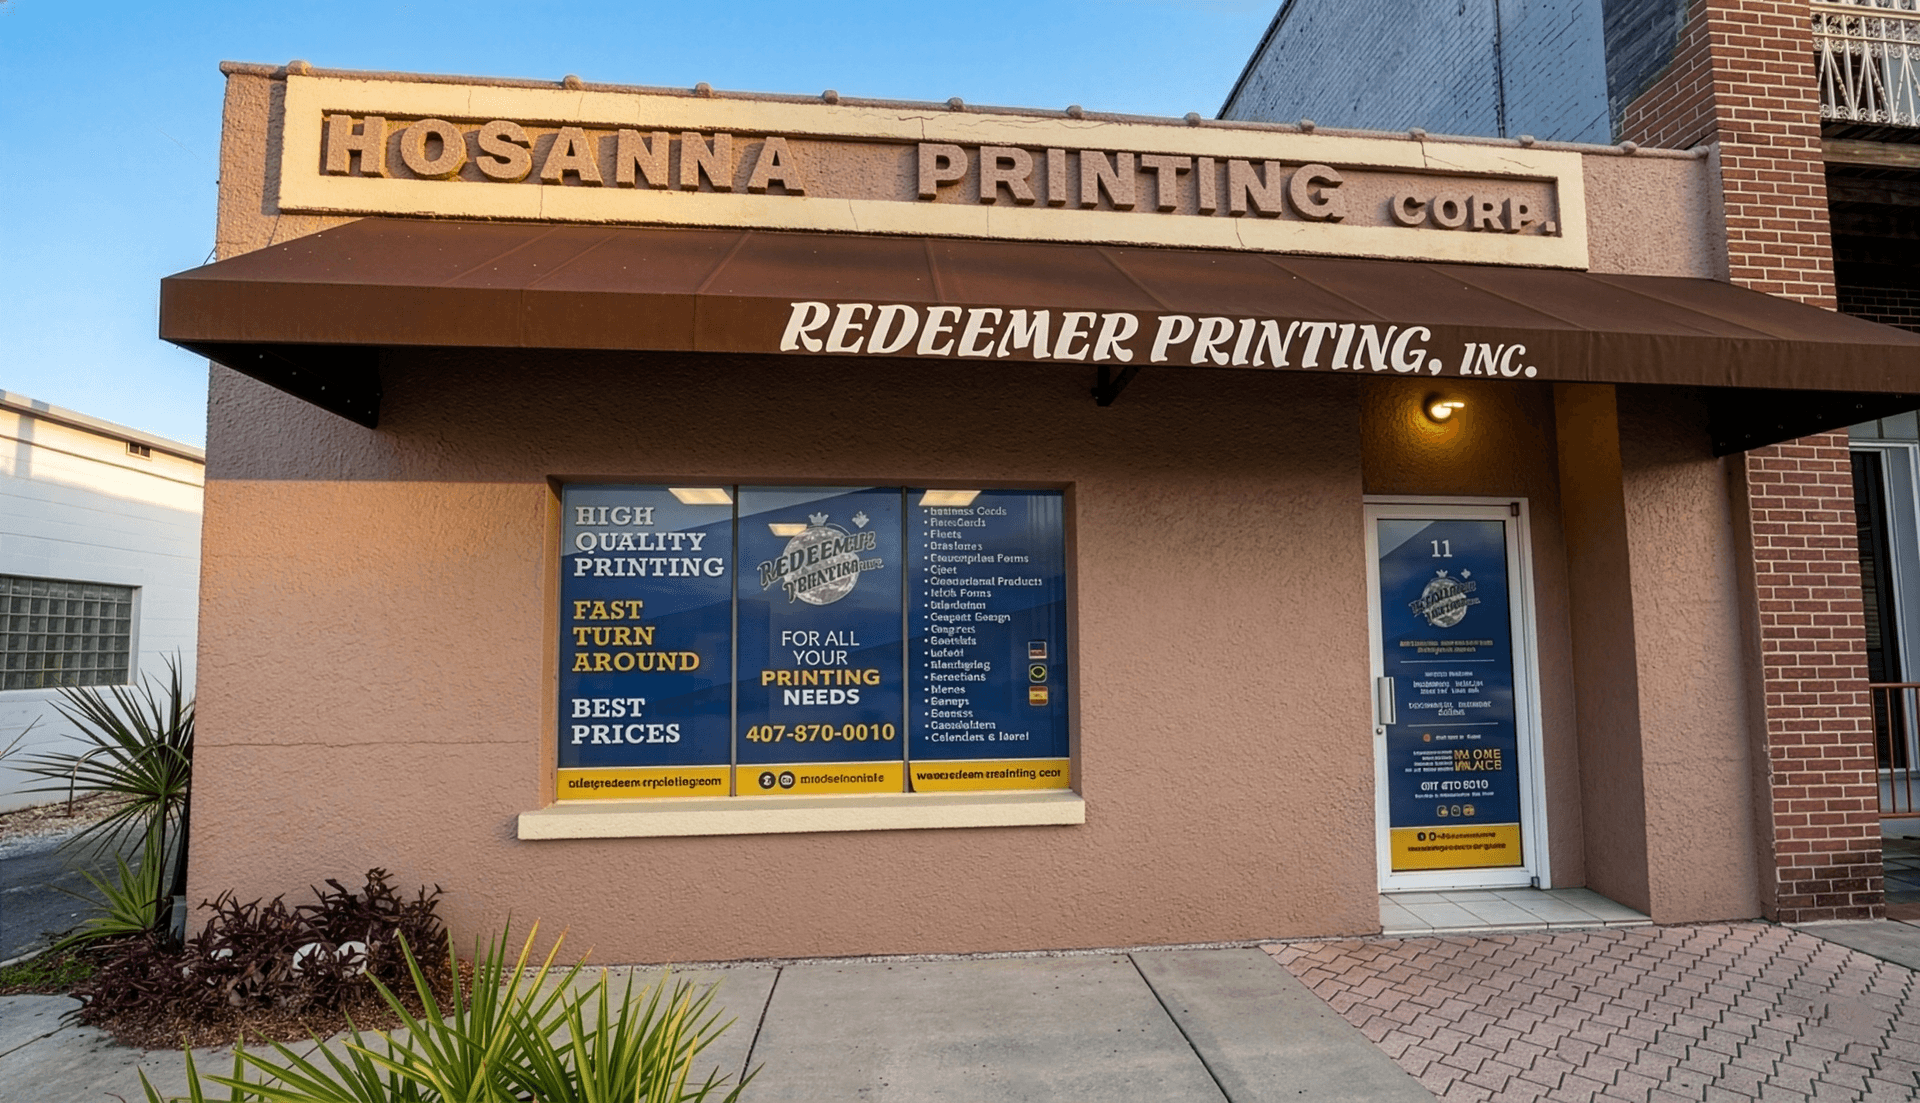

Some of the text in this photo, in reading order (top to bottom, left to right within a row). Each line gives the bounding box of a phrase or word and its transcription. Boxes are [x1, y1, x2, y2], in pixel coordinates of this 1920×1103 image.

[324, 114, 1556, 234] HOSANNA PRINTING CORP.
[779, 302, 1538, 378] REDEEMER PRINTING, INC.
[575, 506, 655, 526] HIGH
[575, 531, 707, 555] QUALITY
[1431, 540, 1453, 557] 11
[573, 557, 725, 577] PRINTING
[573, 600, 644, 620] FAST
[573, 626, 656, 646] TURN
[782, 630, 860, 646] FOR ALL
[572, 651, 700, 672] AROUND
[793, 650, 848, 666] YOUR
[761, 669, 880, 686] PRINTING
[783, 688, 860, 706] NEEDS
[571, 698, 646, 719] BEST
[571, 723, 681, 744] PRICES
[746, 723, 895, 742] 407-870-0010
